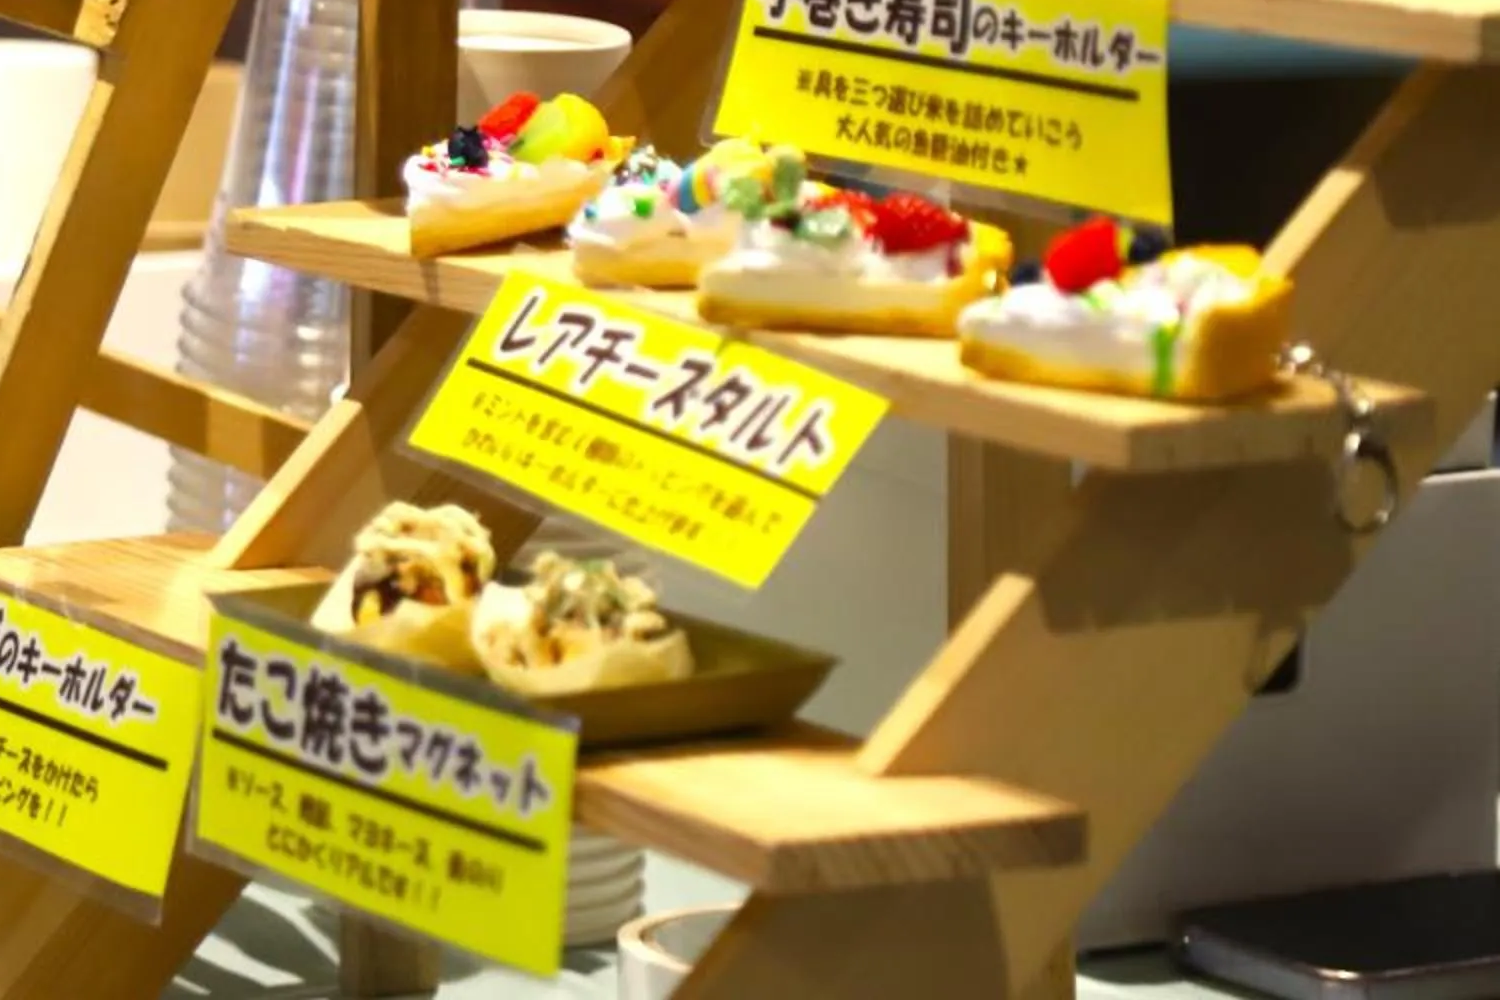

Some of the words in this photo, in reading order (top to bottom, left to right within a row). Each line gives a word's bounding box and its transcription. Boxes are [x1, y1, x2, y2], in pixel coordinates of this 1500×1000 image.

[218, 640, 549, 813] たこ焼きマグネット
